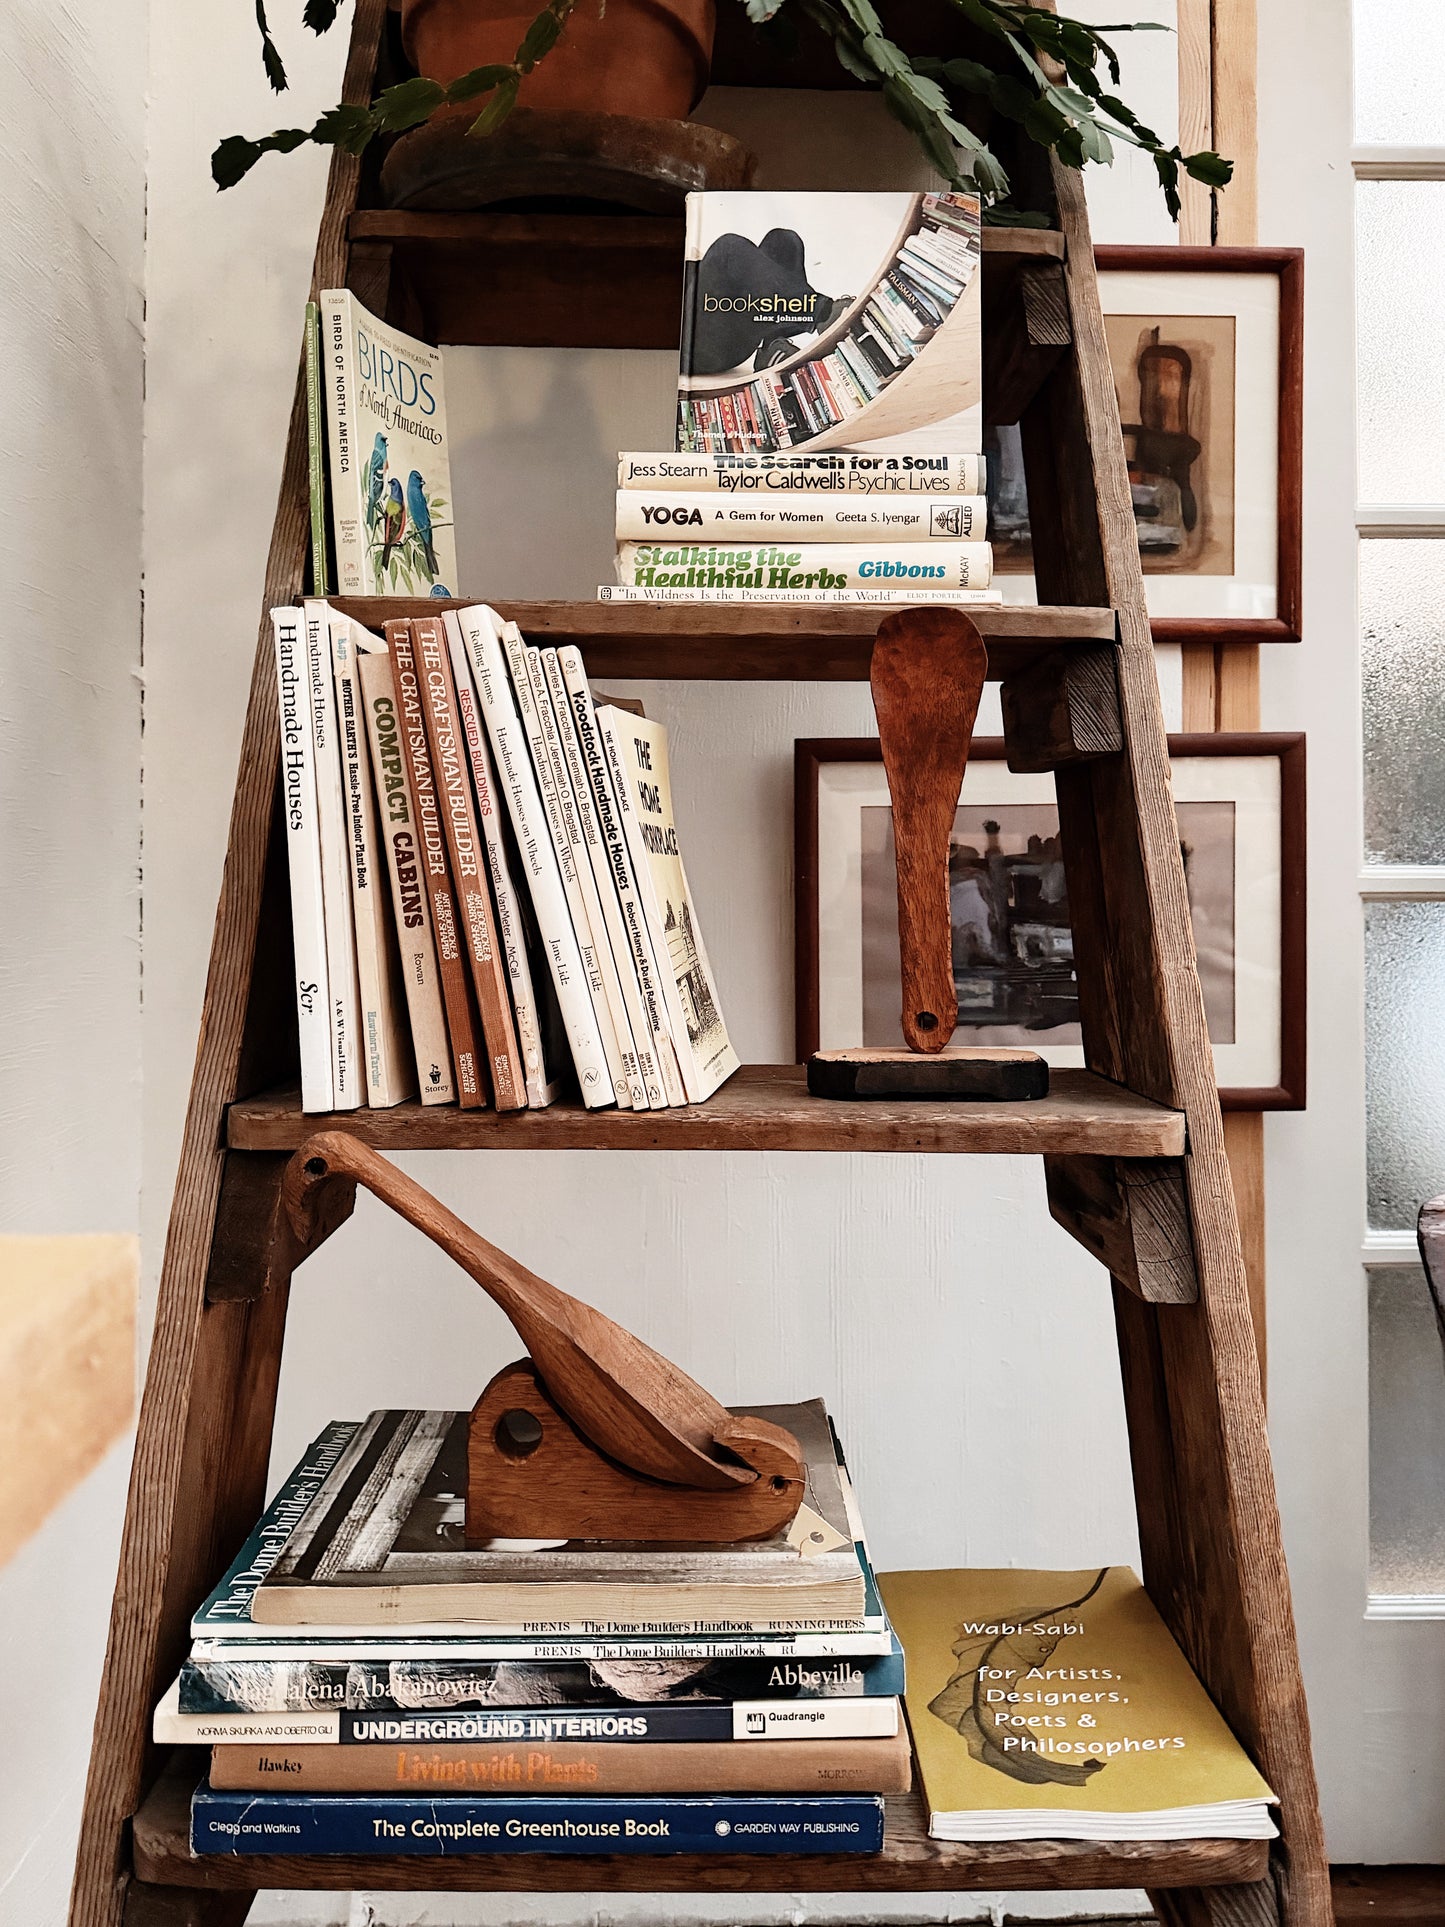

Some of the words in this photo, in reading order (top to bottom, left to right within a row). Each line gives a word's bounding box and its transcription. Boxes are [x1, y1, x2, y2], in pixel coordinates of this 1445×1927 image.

[888, 269, 919, 306] TALISMAN
[703, 293, 817, 313] bookshelf
[332, 314, 342, 350] BIRDS
[753, 314, 775, 322] alex
[776, 314, 814, 323] johnson
[335, 356, 344, 370] OF
[357, 330, 436, 416] BIRDS
[336, 374, 346, 416] NORTH
[359, 384, 367, 408] of
[367, 392, 390, 422] North
[385, 404, 443, 445] America
[338, 421, 349, 474] AMERICA
[628, 462, 656, 480] Jess
[659, 461, 708, 477] Stearn
[713, 456, 757, 469] The
[761, 456, 847, 470] Search
[849, 456, 883, 470] for
[886, 460, 899, 470] a
[902, 456, 949, 471] Soul
[714, 470, 763, 493] Taylor
[766, 470, 845, 490] Caldwell's
[848, 471, 906, 494] Psychic
[909, 475, 950, 491] Lives
[641, 506, 704, 525] YOGA
[715, 511, 724, 520] A
[729, 511, 757, 521] Gem
[759, 510, 776, 521] for
[779, 512, 824, 522] Women
[835, 512, 868, 523] Geeta
[871, 512, 879, 523] S.
[882, 513, 920, 526] Iyengar
[963, 506, 972, 537] ALLIED
[633, 545, 751, 568] Stalking
[756, 546, 801, 566] the
[858, 561, 946, 578] Gibbons
[634, 566, 774, 588] Healthful
[777, 567, 848, 589] Herbs
[959, 556, 969, 586] McKAY
[644, 589, 694, 600] Wildness
[702, 590, 711, 599] Is
[716, 590, 734, 600] the
[742, 590, 810, 600] Preservation
[815, 591, 826, 600] of
[833, 591, 850, 601] the
[393, 630, 413, 669] THE
[469, 630, 484, 667] Rolling
[481, 668, 495, 705] Homes
[527, 652, 542, 688] Charles
[279, 624, 303, 744] Handmade
[536, 689, 544, 699] A.
[342, 679, 353, 718] MOTHER
[400, 674, 434, 791] CRAFTSMAN
[539, 700, 555, 741] Fracchia
[345, 720, 357, 758] EARTH'S
[605, 730, 613, 743] THE
[459, 688, 479, 747] RESCUED
[473, 750, 491, 816] BUILDINGS
[609, 745, 620, 767] HOME
[634, 738, 652, 770] THE
[286, 751, 305, 831] Houses
[349, 763, 361, 813] Hassle-Free
[496, 727, 515, 782] Handmade
[512, 784, 526, 822] Houses
[522, 824, 529, 837] on
[526, 838, 543, 876] Wheels
[561, 790, 570, 799] O.
[572, 691, 599, 771] Woodstock
[592, 767, 617, 841] Handmade
[610, 841, 629, 890] Houses
[614, 769, 630, 812] WORKPLACE
[638, 780, 662, 813] HOME
[373, 697, 410, 823] COMPACT
[392, 831, 424, 929] CABINS
[564, 803, 580, 844] Bragstad
[352, 813, 362, 844] Indoor
[418, 794, 445, 875] BUILDER
[638, 821, 678, 856] WORKPLACE
[354, 844, 366, 868] Plant
[357, 868, 367, 889] Book
[488, 840, 502, 884] Jacopetti
[498, 892, 511, 937] VanMeter
[507, 947, 520, 979] McCall
[625, 902, 638, 930] Robert
[633, 931, 644, 958] Haney
[413, 953, 424, 985] Rowan
[549, 938, 562, 962] Jane
[556, 964, 570, 986] Lidz
[639, 958, 647, 966] &
[642, 966, 651, 990] David
[336, 1008, 343, 1016] &
[337, 1018, 344, 1029] W
[338, 1030, 346, 1060] Visual
[368, 1011, 379, 1088] Hawthorn/Tarcher
[425, 1085, 449, 1093] Storey
[298, 1424, 359, 1479] Handbook
[259, 1480, 320, 1538] Builder's
[228, 1539, 284, 1587] Dome
[206, 1583, 255, 1619] The
[523, 1621, 570, 1632] PRENIS
[581, 1621, 605, 1632] The
[607, 1621, 639, 1633] Dome
[642, 1621, 691, 1633] Builder's
[694, 1620, 754, 1632] Handbook
[769, 1620, 825, 1629] RUNNING
[830, 1620, 865, 1628] PRESS
[963, 1622, 1085, 1635] Wabi-Sabi
[353, 1672, 497, 1699] Abakanowicz
[767, 1663, 863, 1687] Abbeville
[977, 1665, 1016, 1682] for
[1026, 1667, 1122, 1681] Artists,
[986, 1689, 1130, 1705] Designers,
[197, 1727, 227, 1736] NORMA
[229, 1727, 263, 1735] SKURKA
[264, 1727, 283, 1735] AND
[283, 1726, 317, 1735] OBERTO
[353, 1720, 525, 1741] UNDERGROUND
[530, 1718, 647, 1737] INTERIORS
[769, 1712, 825, 1723] Quadrangle
[994, 1713, 1067, 1727] Poets
[1077, 1713, 1097, 1727] &
[1003, 1735, 1186, 1756] Philosophers
[258, 1757, 303, 1774] Hawkey
[397, 1752, 468, 1786] Living
[471, 1752, 522, 1782] with
[527, 1752, 598, 1783] Plants
[209, 1822, 240, 1835] Clegg
[242, 1822, 262, 1834] and
[264, 1822, 301, 1834] Watkins
[372, 1819, 406, 1837] The
[410, 1819, 500, 1839] Complete
[505, 1820, 620, 1838] Greenhouse
[624, 1819, 671, 1837] Book
[734, 1823, 776, 1833] GARDEN
[779, 1823, 801, 1833] WAY
[803, 1823, 860, 1833] PUBLISHING
